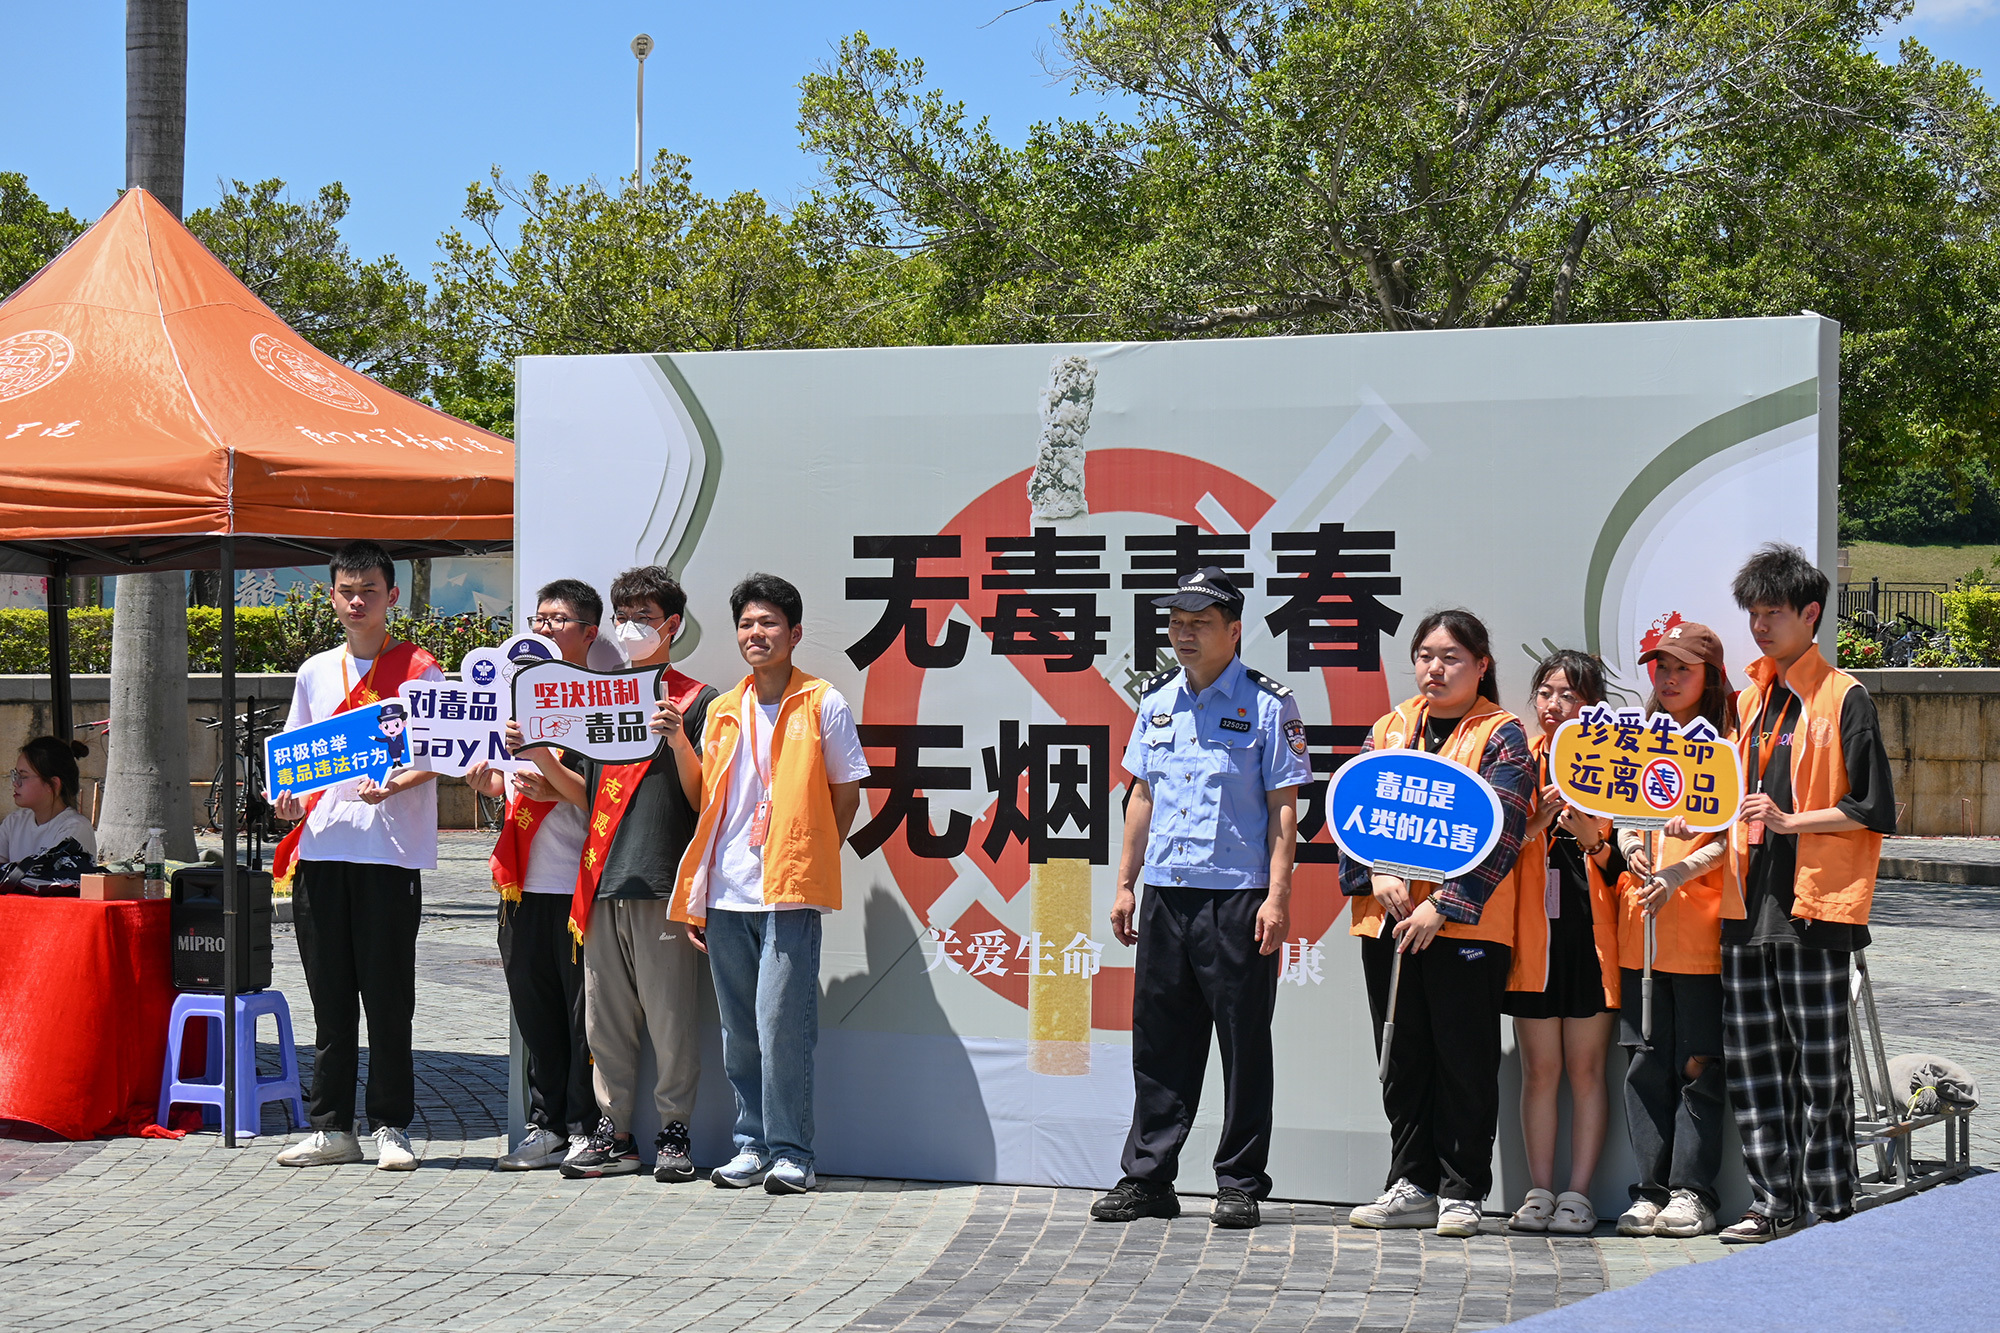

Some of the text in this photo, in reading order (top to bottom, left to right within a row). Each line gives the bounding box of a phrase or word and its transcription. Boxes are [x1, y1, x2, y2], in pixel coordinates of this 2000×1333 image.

[1669, 627, 1683, 639] R
[409, 689, 498, 722] 对毒品
[534, 678, 640, 709] 坚决抵制
[585, 711, 648, 744] 毒品
[1221, 720, 1249, 731] 325023
[1577, 707, 1716, 765] 珍爱生命
[273, 734, 348, 766] 积极检举
[277, 747, 388, 786] 毒品违法行为
[1375, 771, 1456, 810] 毒品是
[1568, 753, 1720, 815] 远离毒品
[584, 763, 641, 871] 志愿者
[1342, 804, 1478, 853] 人类的公害
[178, 934, 226, 952] MIPRO
[920, 929, 1105, 980] 关爱生命
